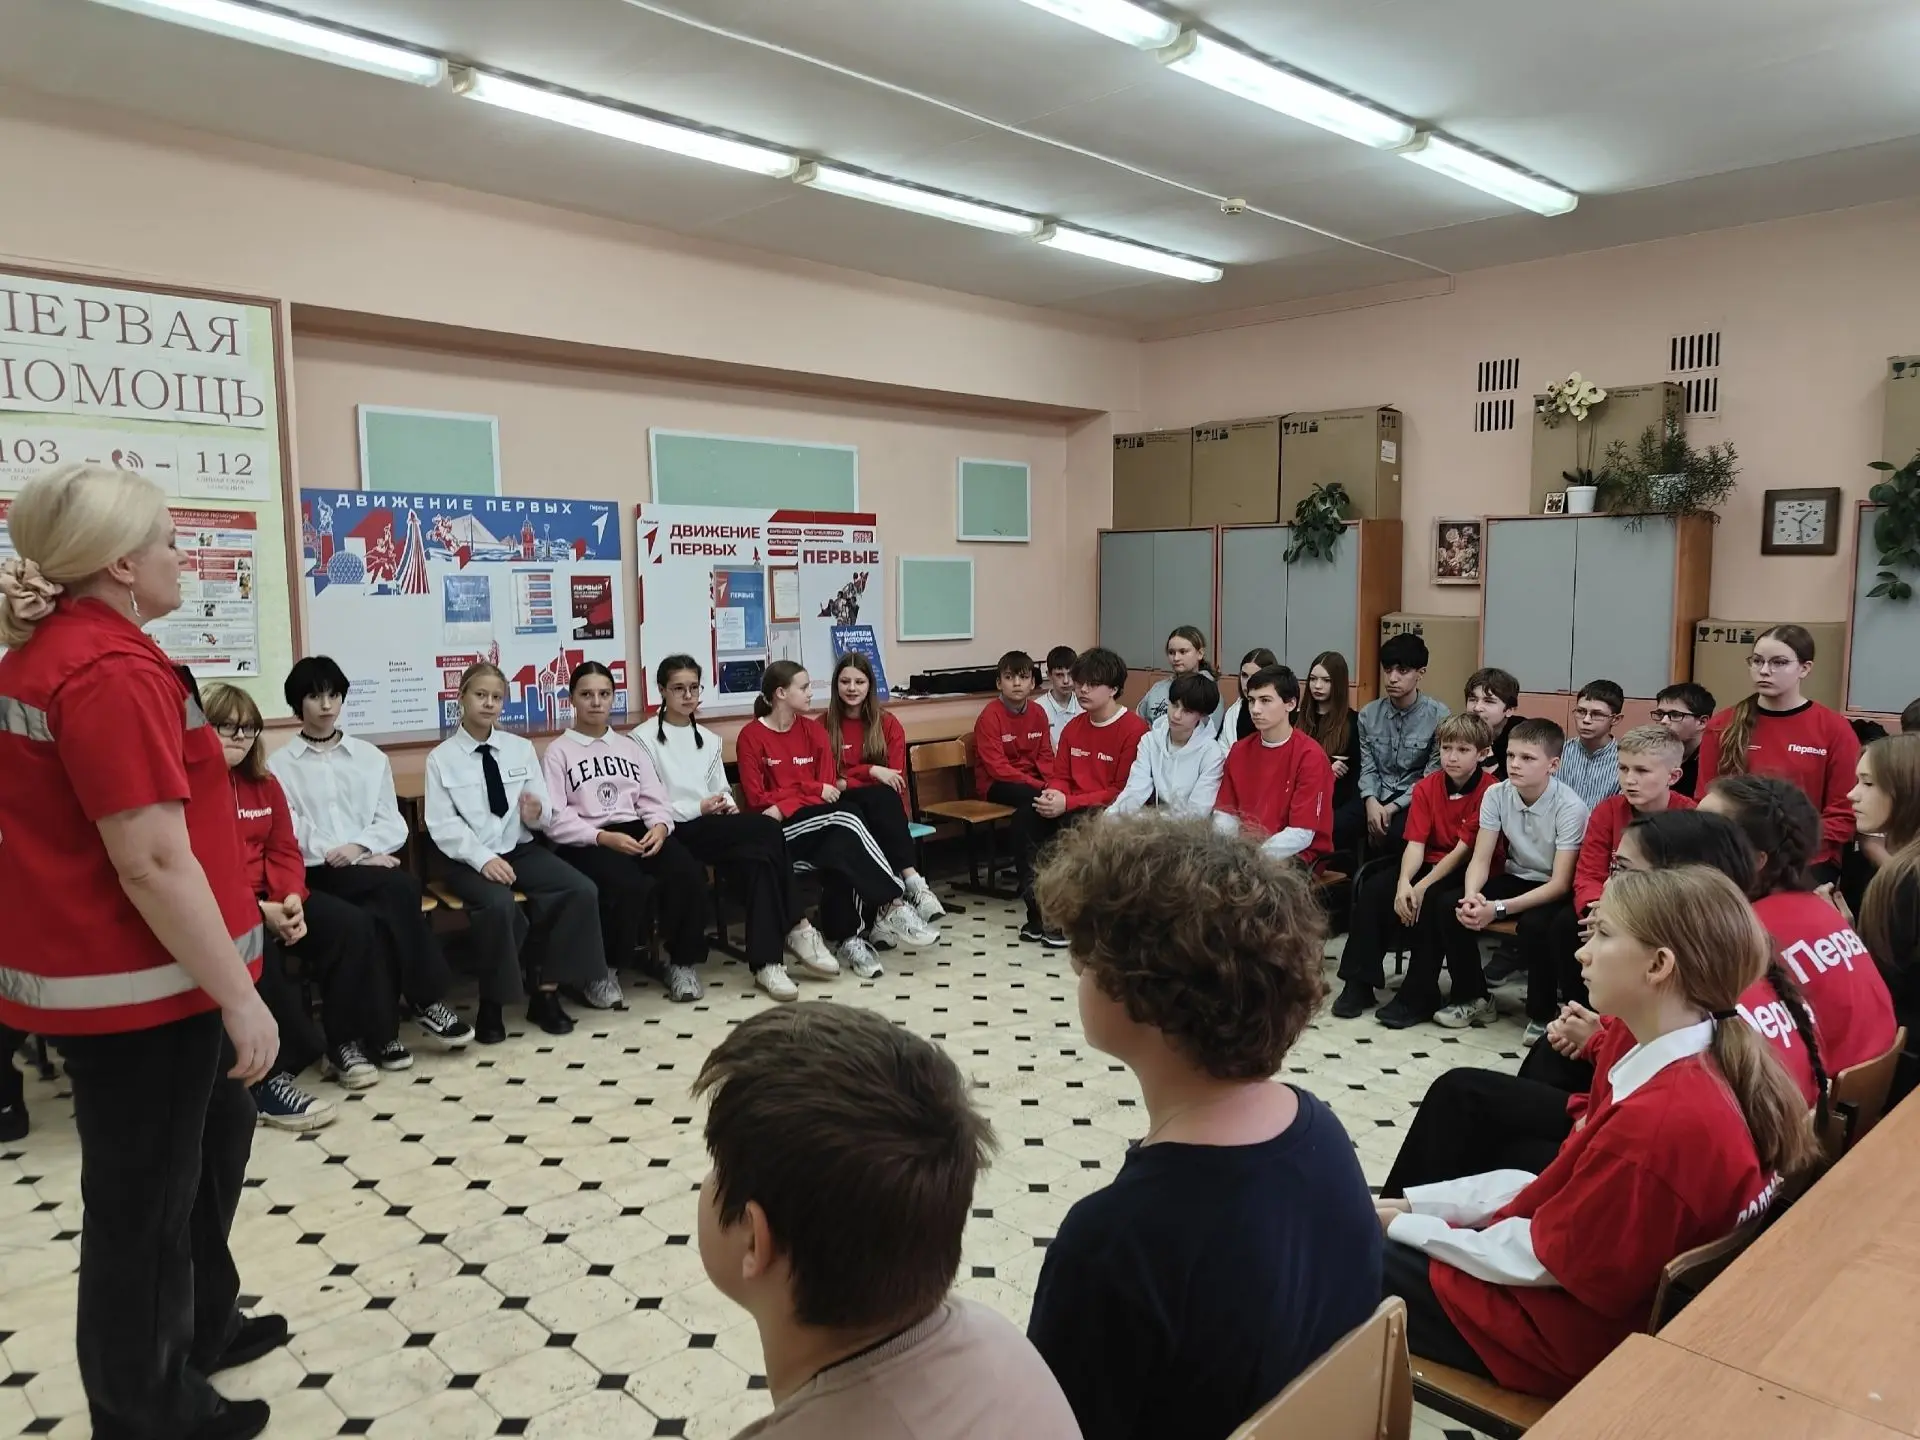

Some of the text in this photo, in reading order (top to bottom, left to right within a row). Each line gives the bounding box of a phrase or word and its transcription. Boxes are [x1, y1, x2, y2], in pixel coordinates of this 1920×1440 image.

[196, 451, 252, 476] 112
[335, 494, 572, 514] ДВИЖЕНИЕ ПЕРВЫХ
[669, 524, 761, 539] ДВИЖЕНИЕ
[670, 543, 737, 556] ПЕРВЫХ
[803, 550, 879, 564] ПЕРВЫЕ
[1787, 743, 1827, 756] Первые
[567, 755, 641, 792] LEAGUE
[602, 789, 611, 799] W
[1780, 928, 1868, 984] Перв
